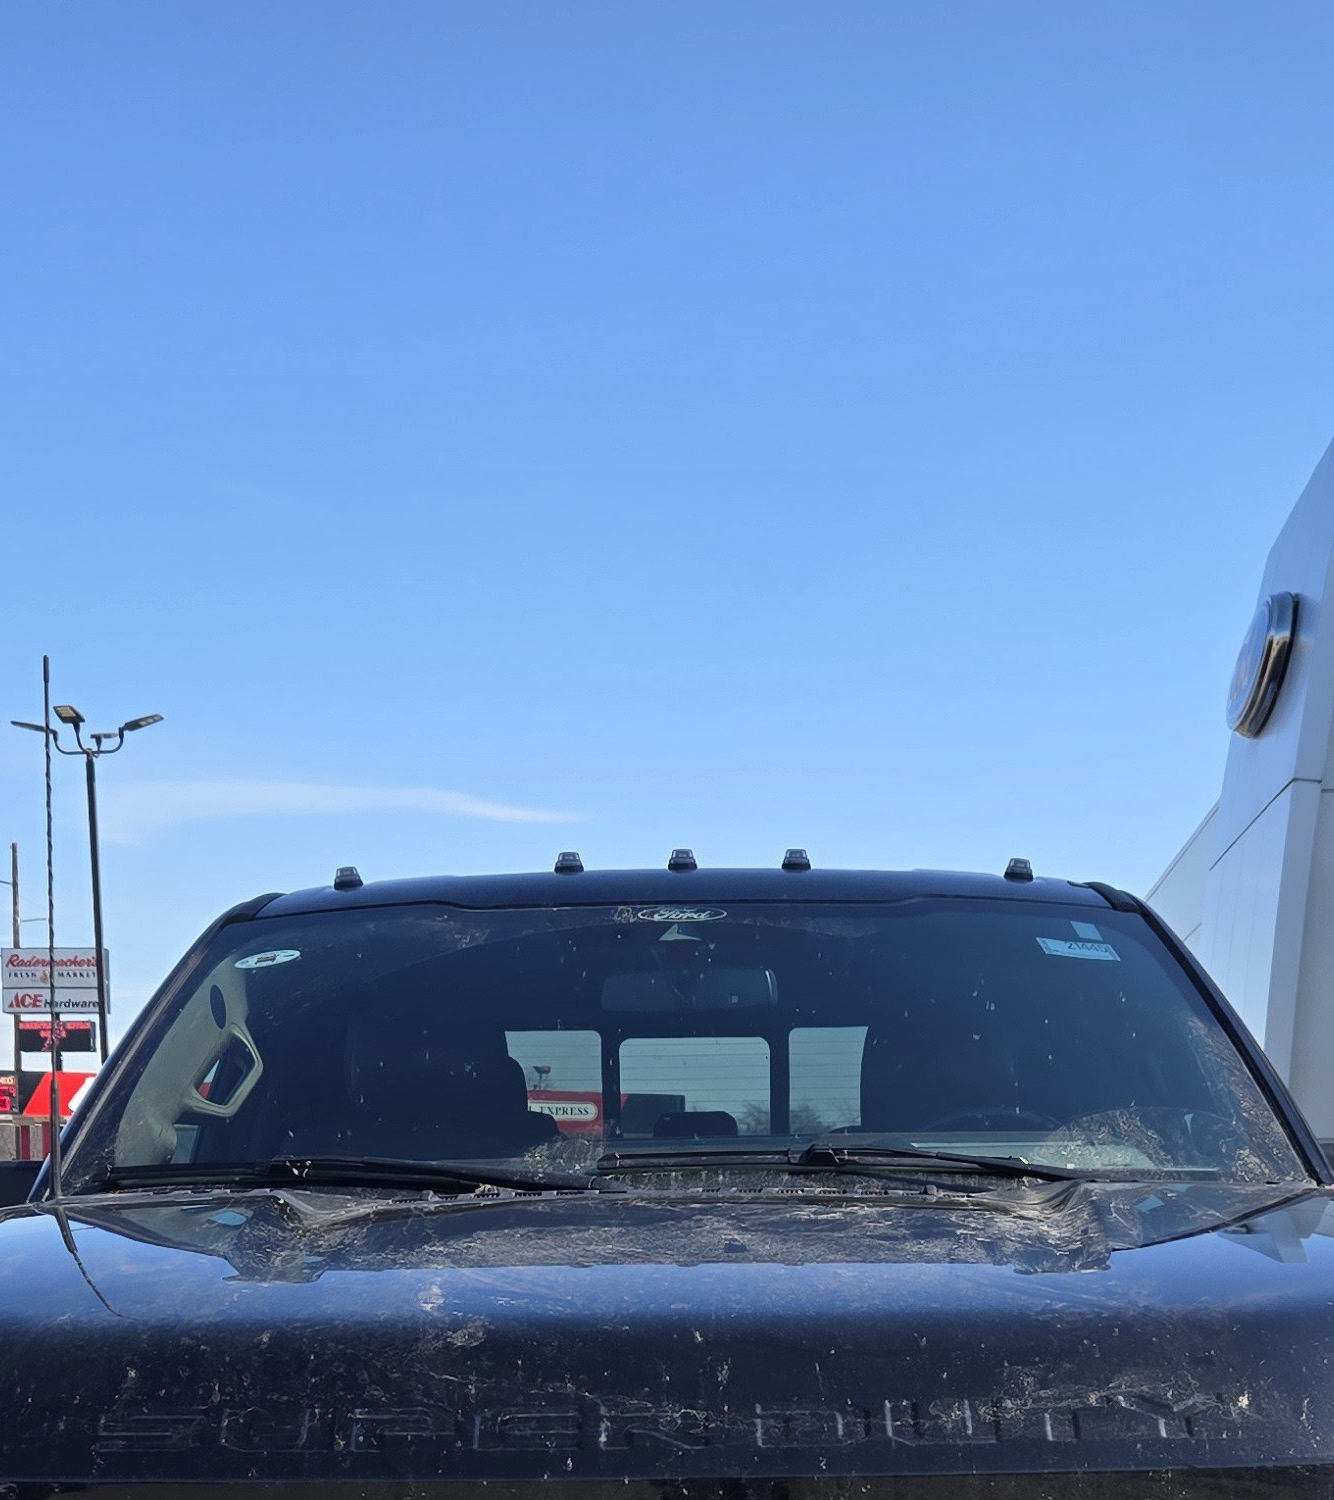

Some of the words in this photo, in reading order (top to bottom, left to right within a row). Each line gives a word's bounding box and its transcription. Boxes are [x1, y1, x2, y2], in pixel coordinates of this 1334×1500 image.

[7, 991, 44, 1009] ACE
[540, 1106, 589, 1116] EXPRESS
[91, 1404, 713, 1455] SUPER
[754, 1396, 1257, 1449] DUTY
